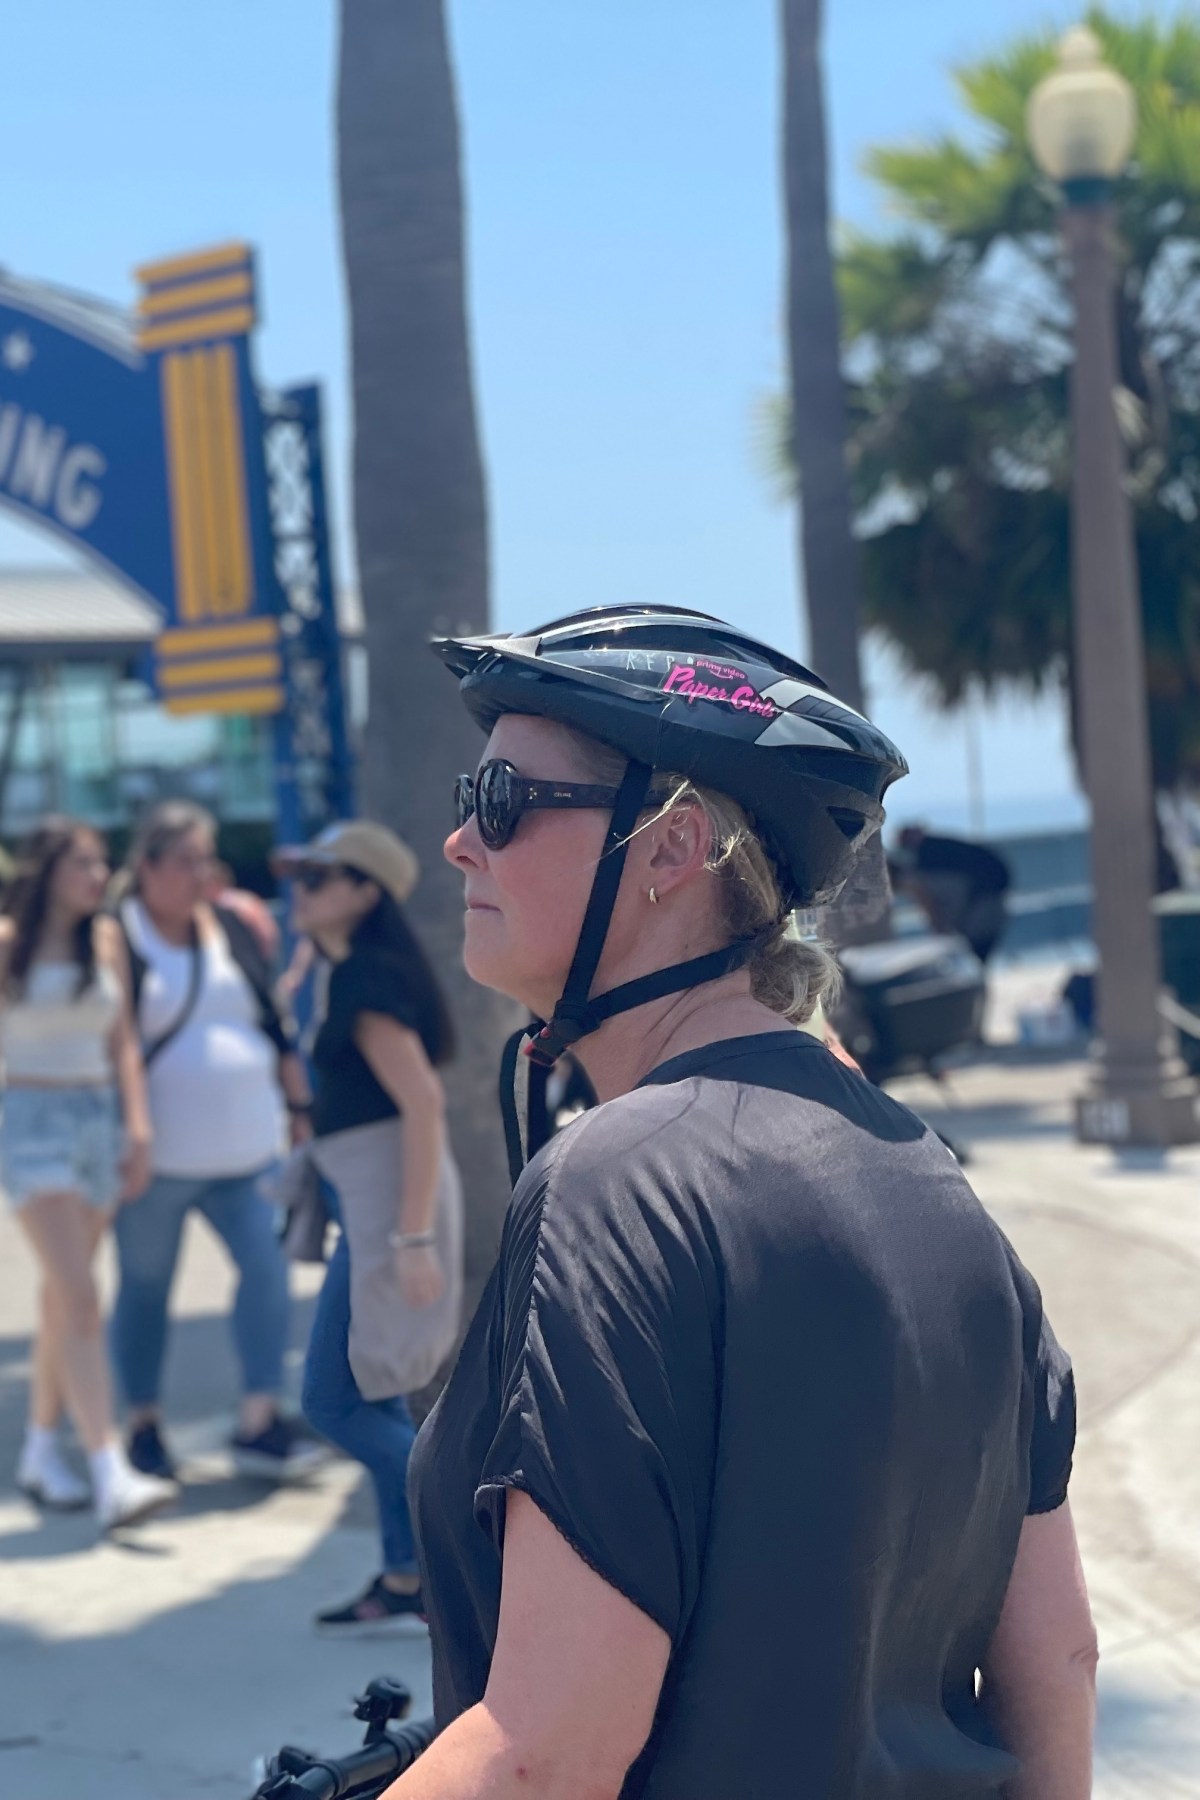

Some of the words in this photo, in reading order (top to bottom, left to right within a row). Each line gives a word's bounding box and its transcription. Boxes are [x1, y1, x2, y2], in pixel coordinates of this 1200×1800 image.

[696, 659, 722, 672] prime
[723, 667, 745, 680] video
[663, 665, 730, 704] Paper
[731, 685, 776, 718] Girls
